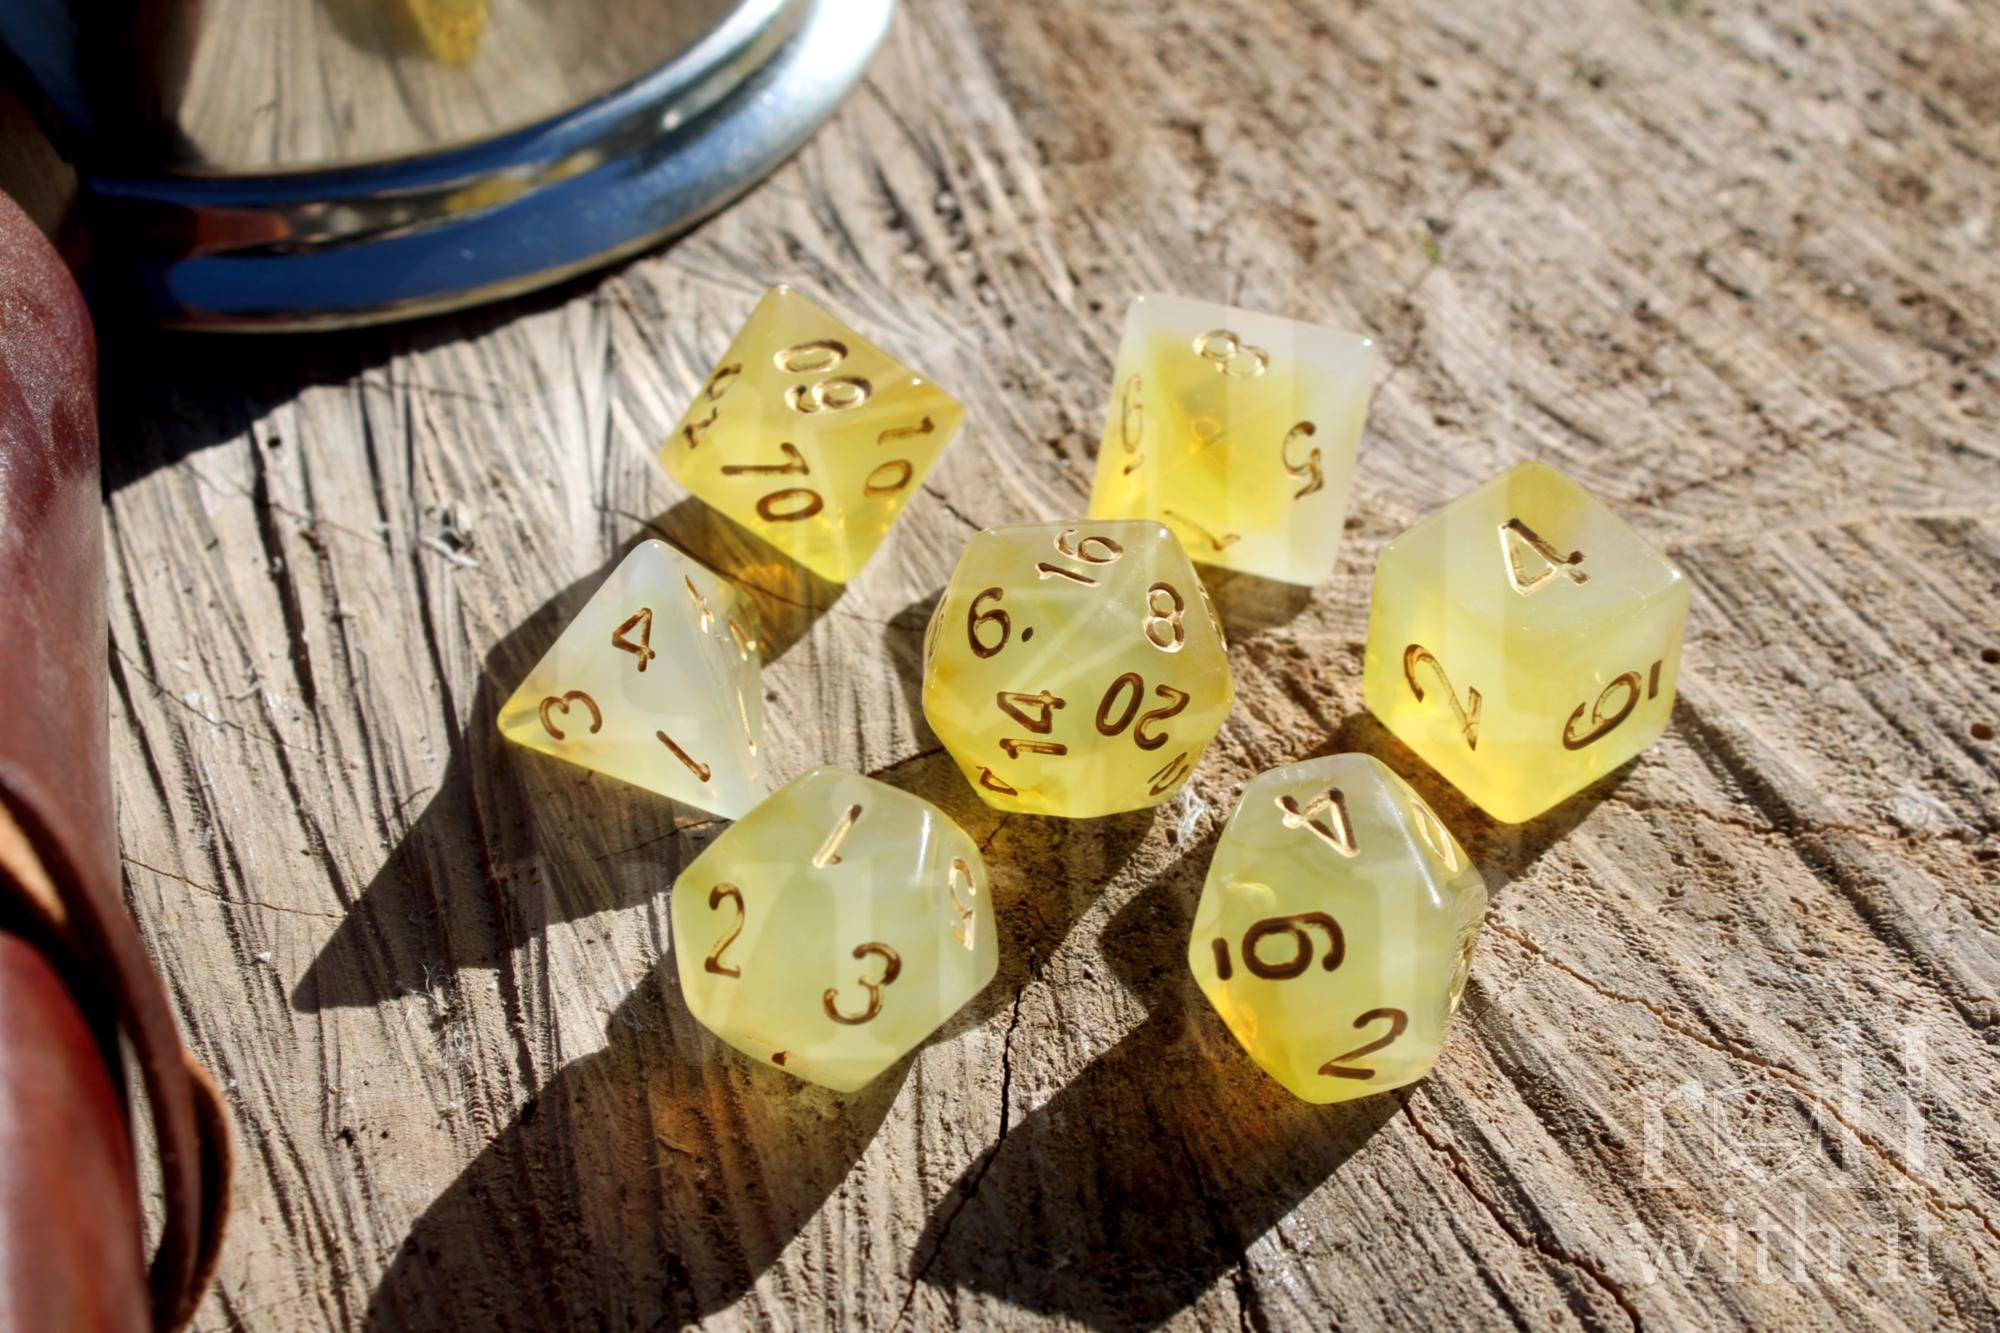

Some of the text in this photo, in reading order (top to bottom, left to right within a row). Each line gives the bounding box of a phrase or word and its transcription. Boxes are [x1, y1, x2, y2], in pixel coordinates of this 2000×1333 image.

[1191, 329, 1270, 377] 8
[1282, 421, 1324, 500] 5
[1035, 528, 1124, 588] 16
[1497, 517, 1592, 596] 4
[612, 607, 656, 673] 4
[1143, 582, 1185, 653] 8
[539, 690, 602, 741] 3
[996, 690, 1068, 759] 14
[1095, 672, 1190, 751] 20
[1403, 643, 1482, 752] 2
[656, 730, 711, 783] 1
[812, 803, 863, 869] 1
[1274, 786, 1360, 859] 4
[705, 882, 746, 979] 2
[823, 941, 903, 1026] 3
[1317, 1007, 1409, 1080] 2
